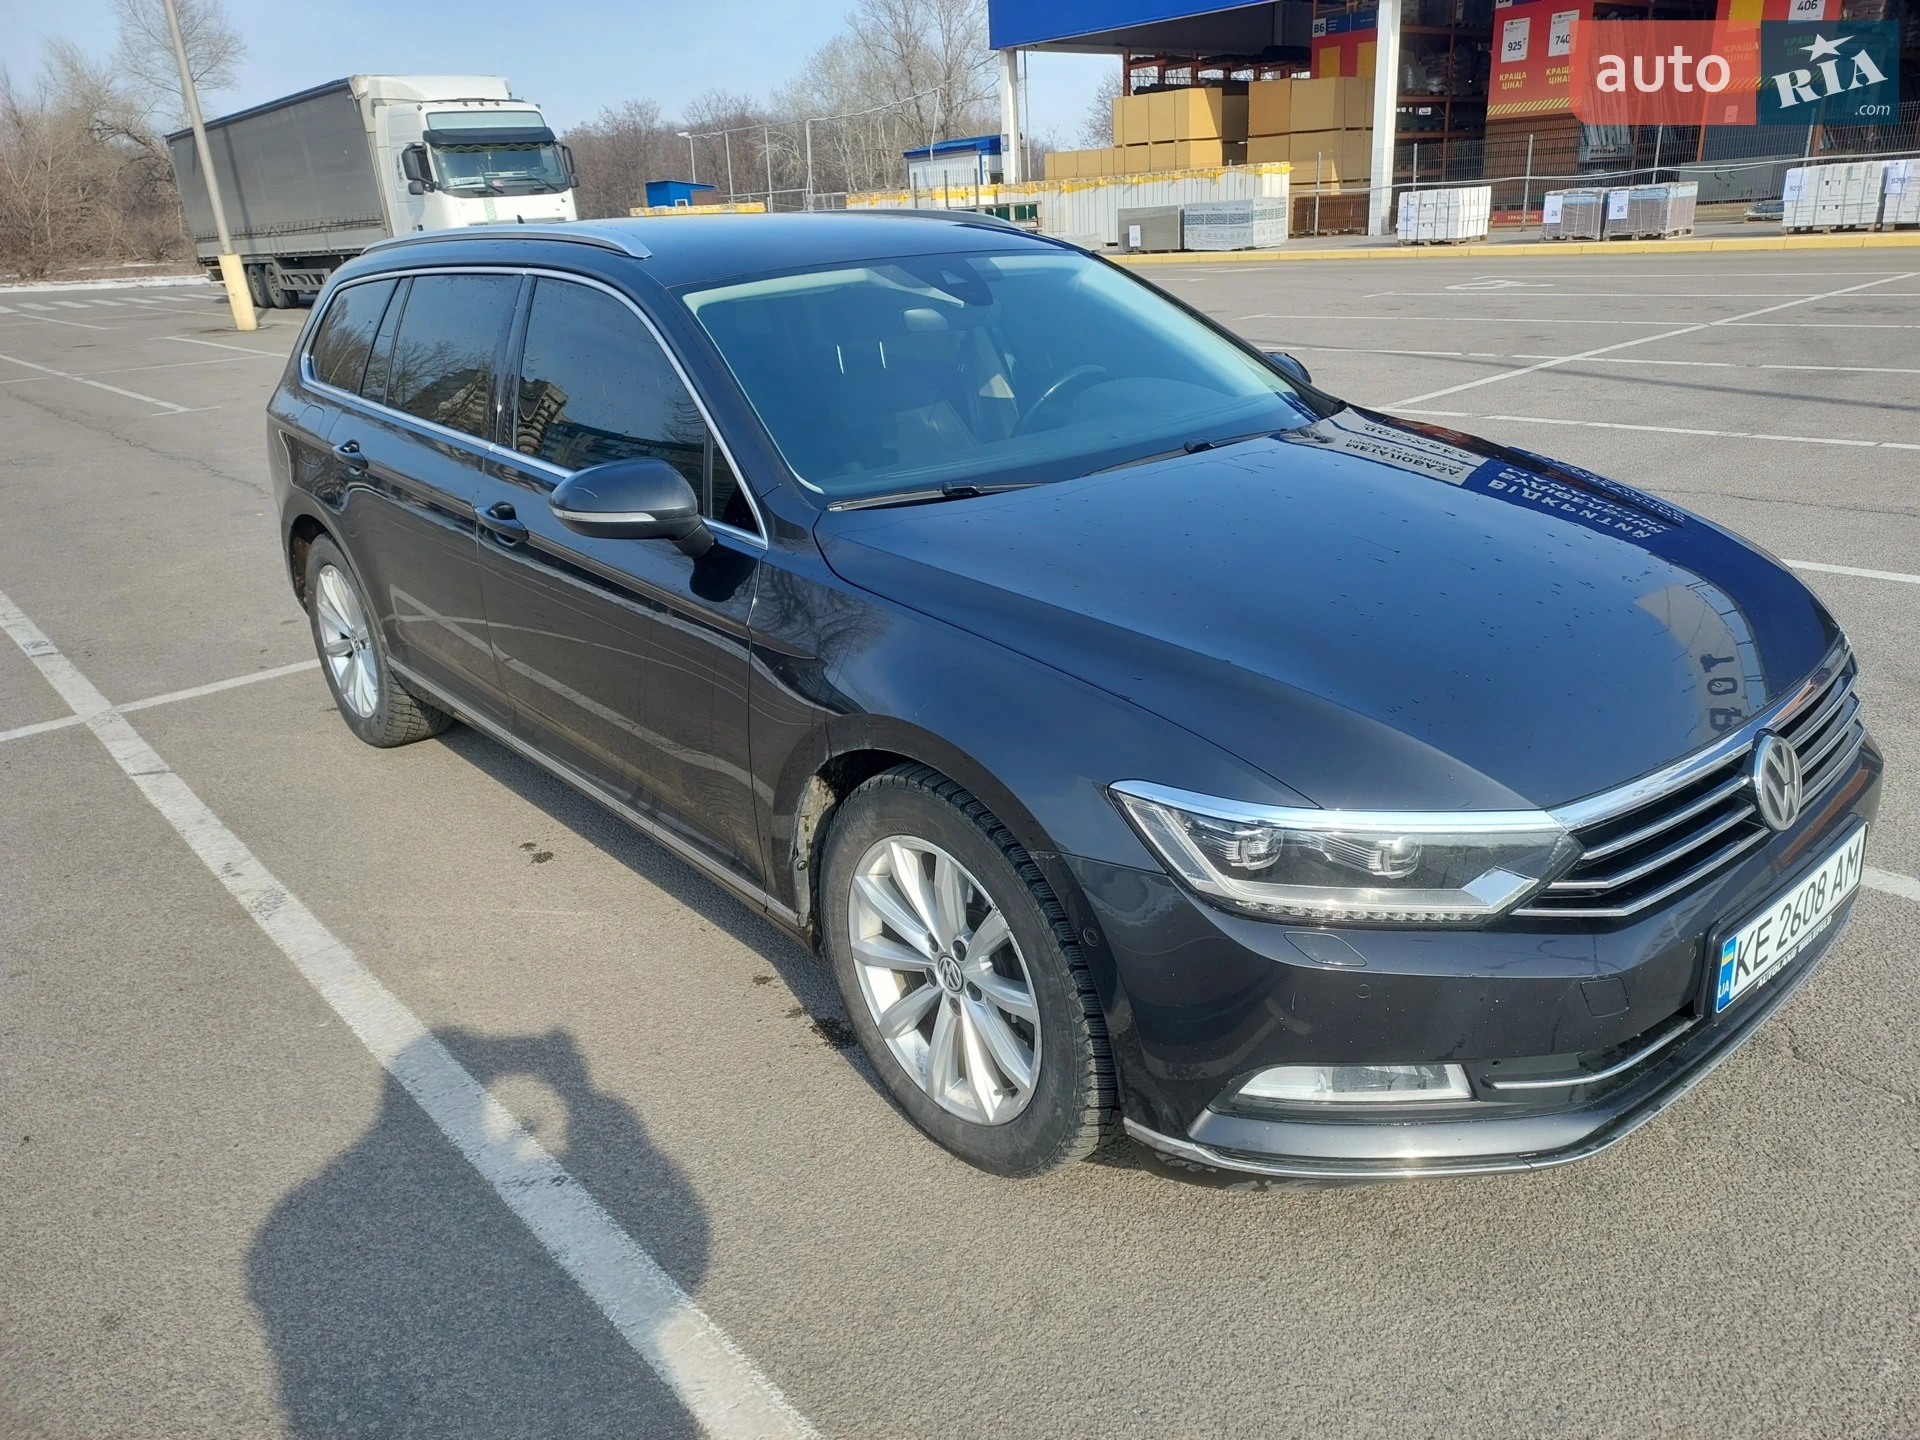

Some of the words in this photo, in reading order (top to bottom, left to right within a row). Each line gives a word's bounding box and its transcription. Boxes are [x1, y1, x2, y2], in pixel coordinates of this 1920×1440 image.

[1797, 0, 1817, 11] 406
[1507, 41, 1522, 51] 925
[1499, 71, 1527, 81] КРАЩА
[1502, 80, 1523, 90] ЦІНА!
[1733, 916, 1773, 988] KE
[1775, 870, 1828, 952] 2608
[1829, 836, 1862, 897] AM
